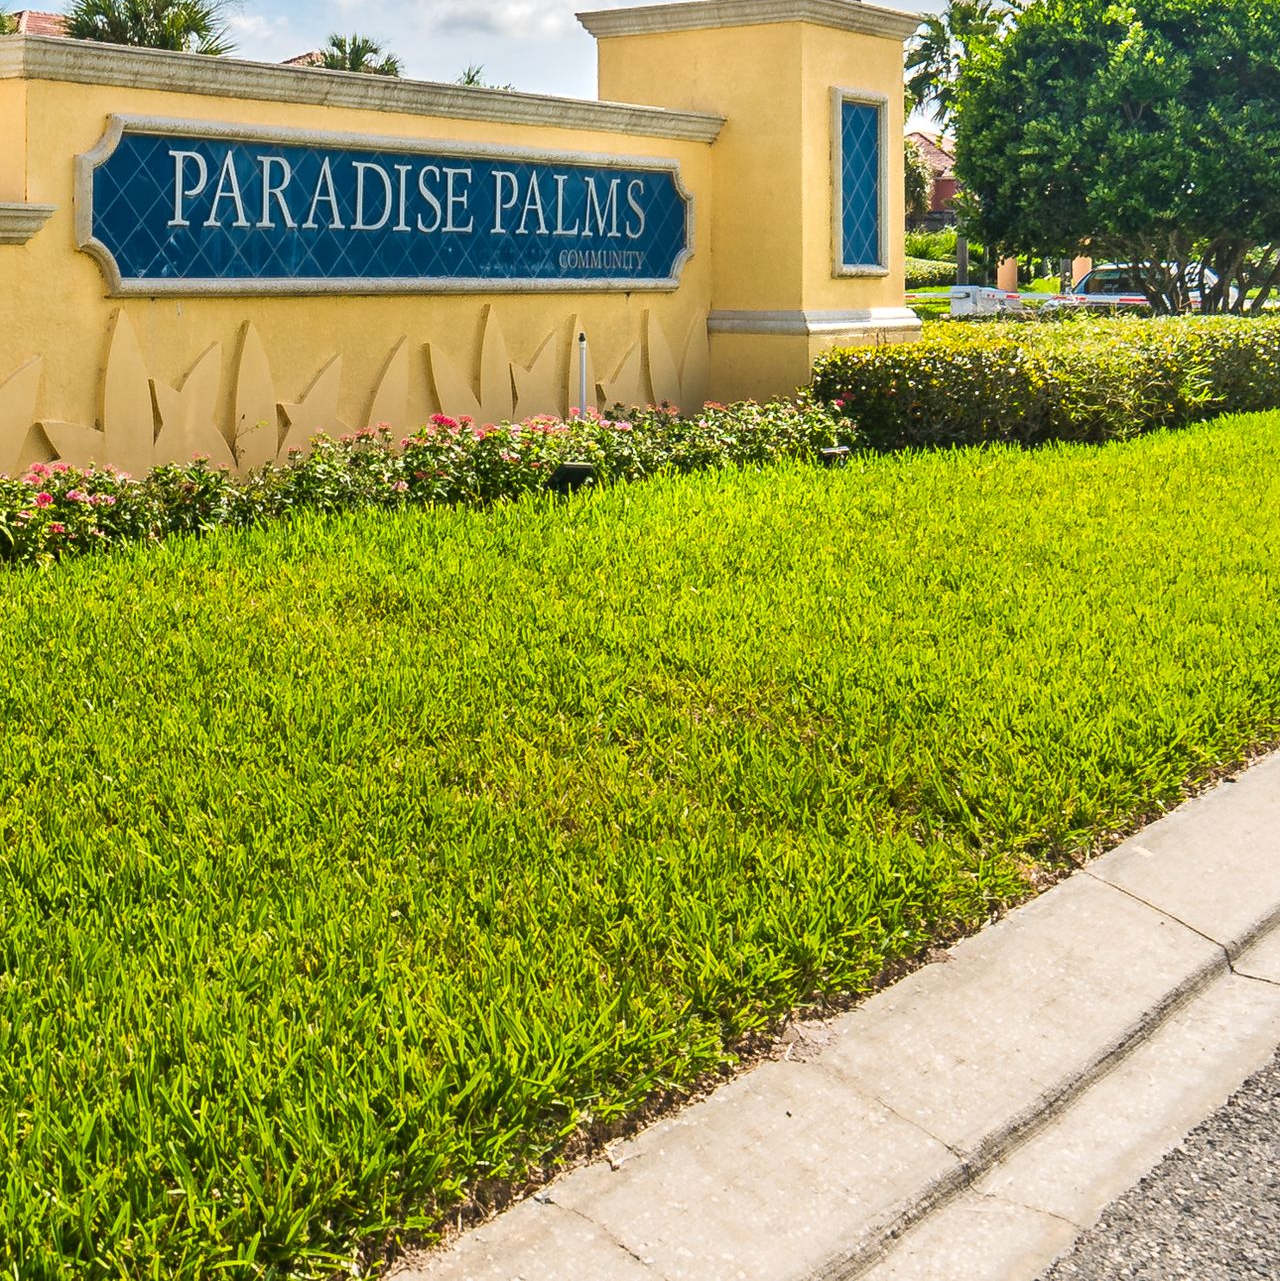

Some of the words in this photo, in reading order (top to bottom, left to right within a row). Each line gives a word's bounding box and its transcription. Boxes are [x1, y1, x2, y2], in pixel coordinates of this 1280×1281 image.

[167, 149, 474, 233] PARADISE
[490, 170, 645, 239] PALMS
[559, 249, 644, 270] COMMUNITY
